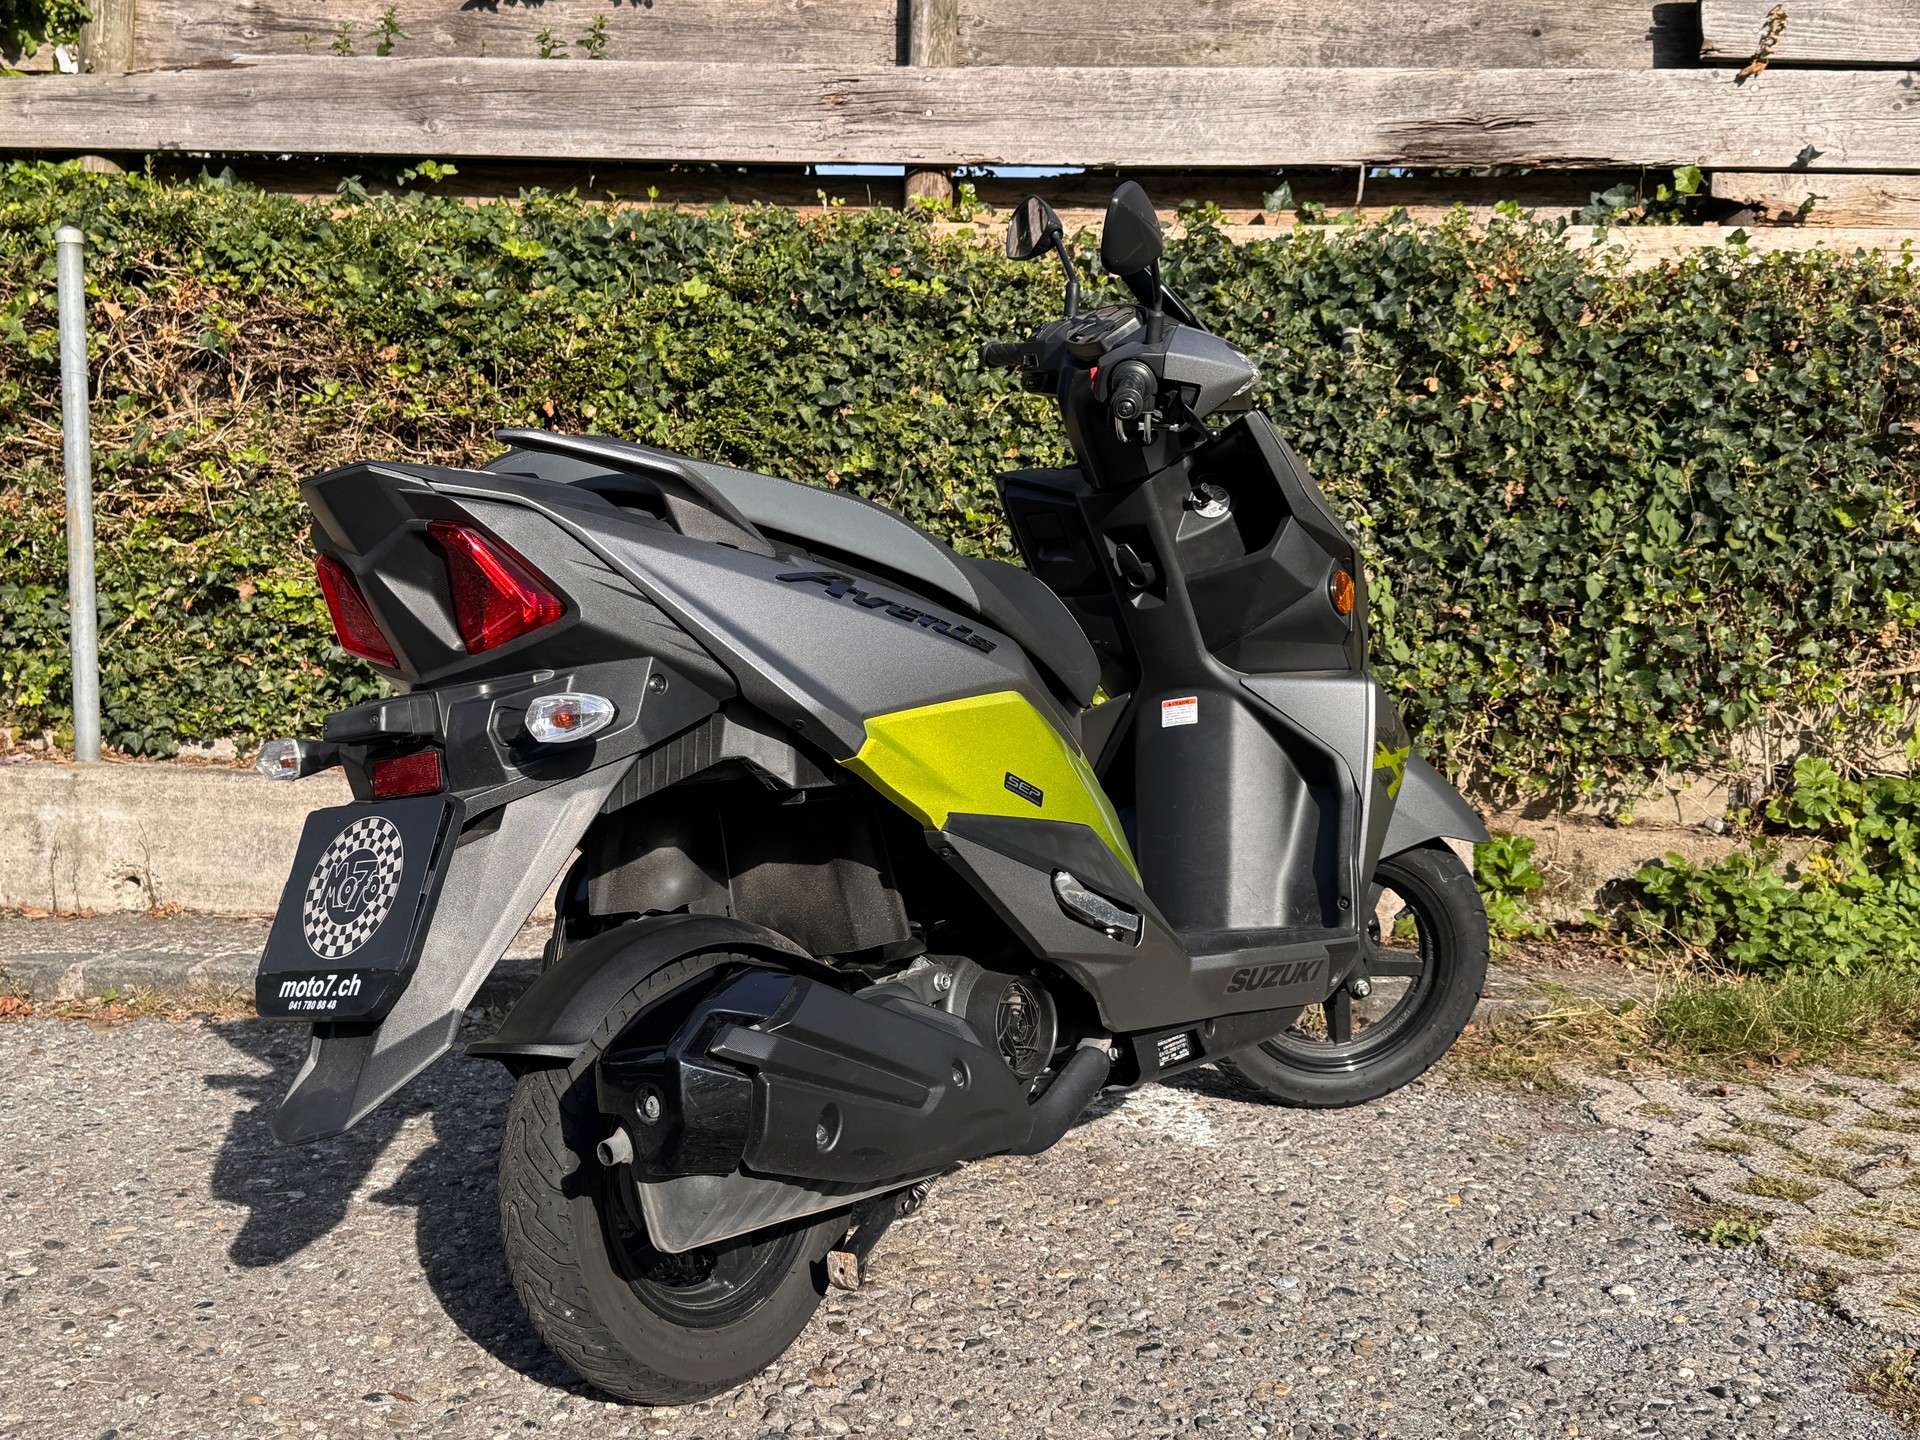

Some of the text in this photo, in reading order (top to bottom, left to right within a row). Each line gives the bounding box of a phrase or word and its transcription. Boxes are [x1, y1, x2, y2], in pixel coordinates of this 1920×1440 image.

[1006, 775, 1041, 797] SEP
[278, 973, 362, 998] moto7.ch
[1226, 959, 1325, 993] SUZUKI
[288, 1000, 302, 1011] 041
[316, 999, 327, 1010] 88
[326, 999, 338, 1010] 48
